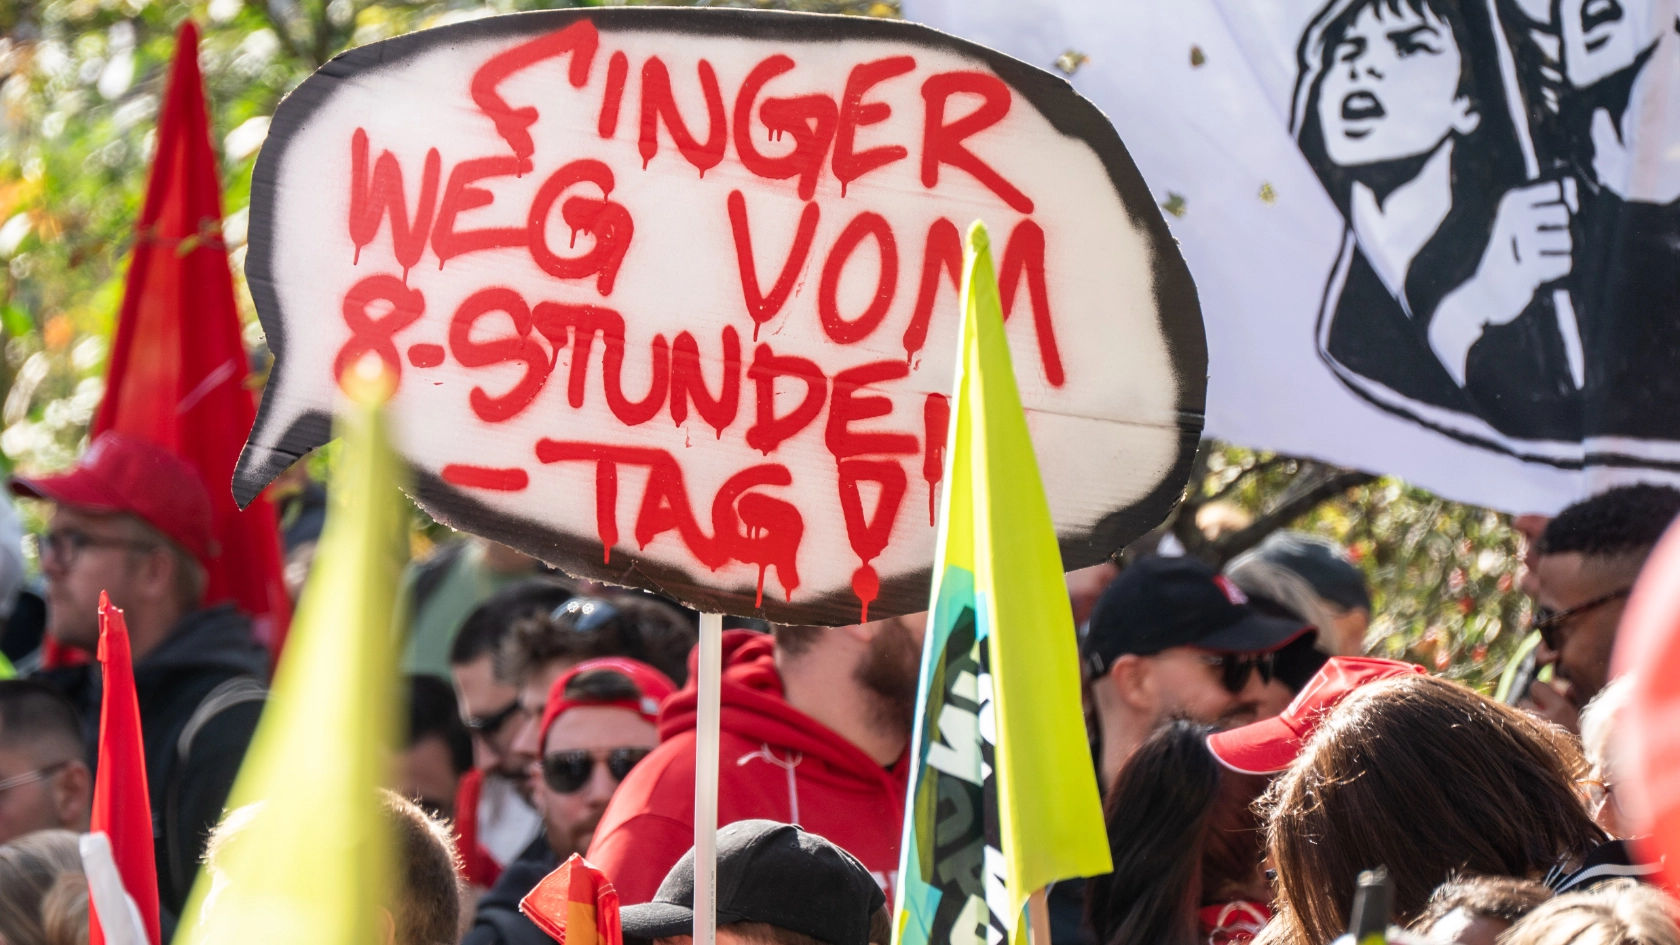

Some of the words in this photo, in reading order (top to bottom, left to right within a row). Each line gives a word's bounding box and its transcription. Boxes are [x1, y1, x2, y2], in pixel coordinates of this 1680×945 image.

[471, 19, 1034, 214] FINGER
[348, 127, 634, 296] WEG
[728, 189, 1065, 388] VOM
